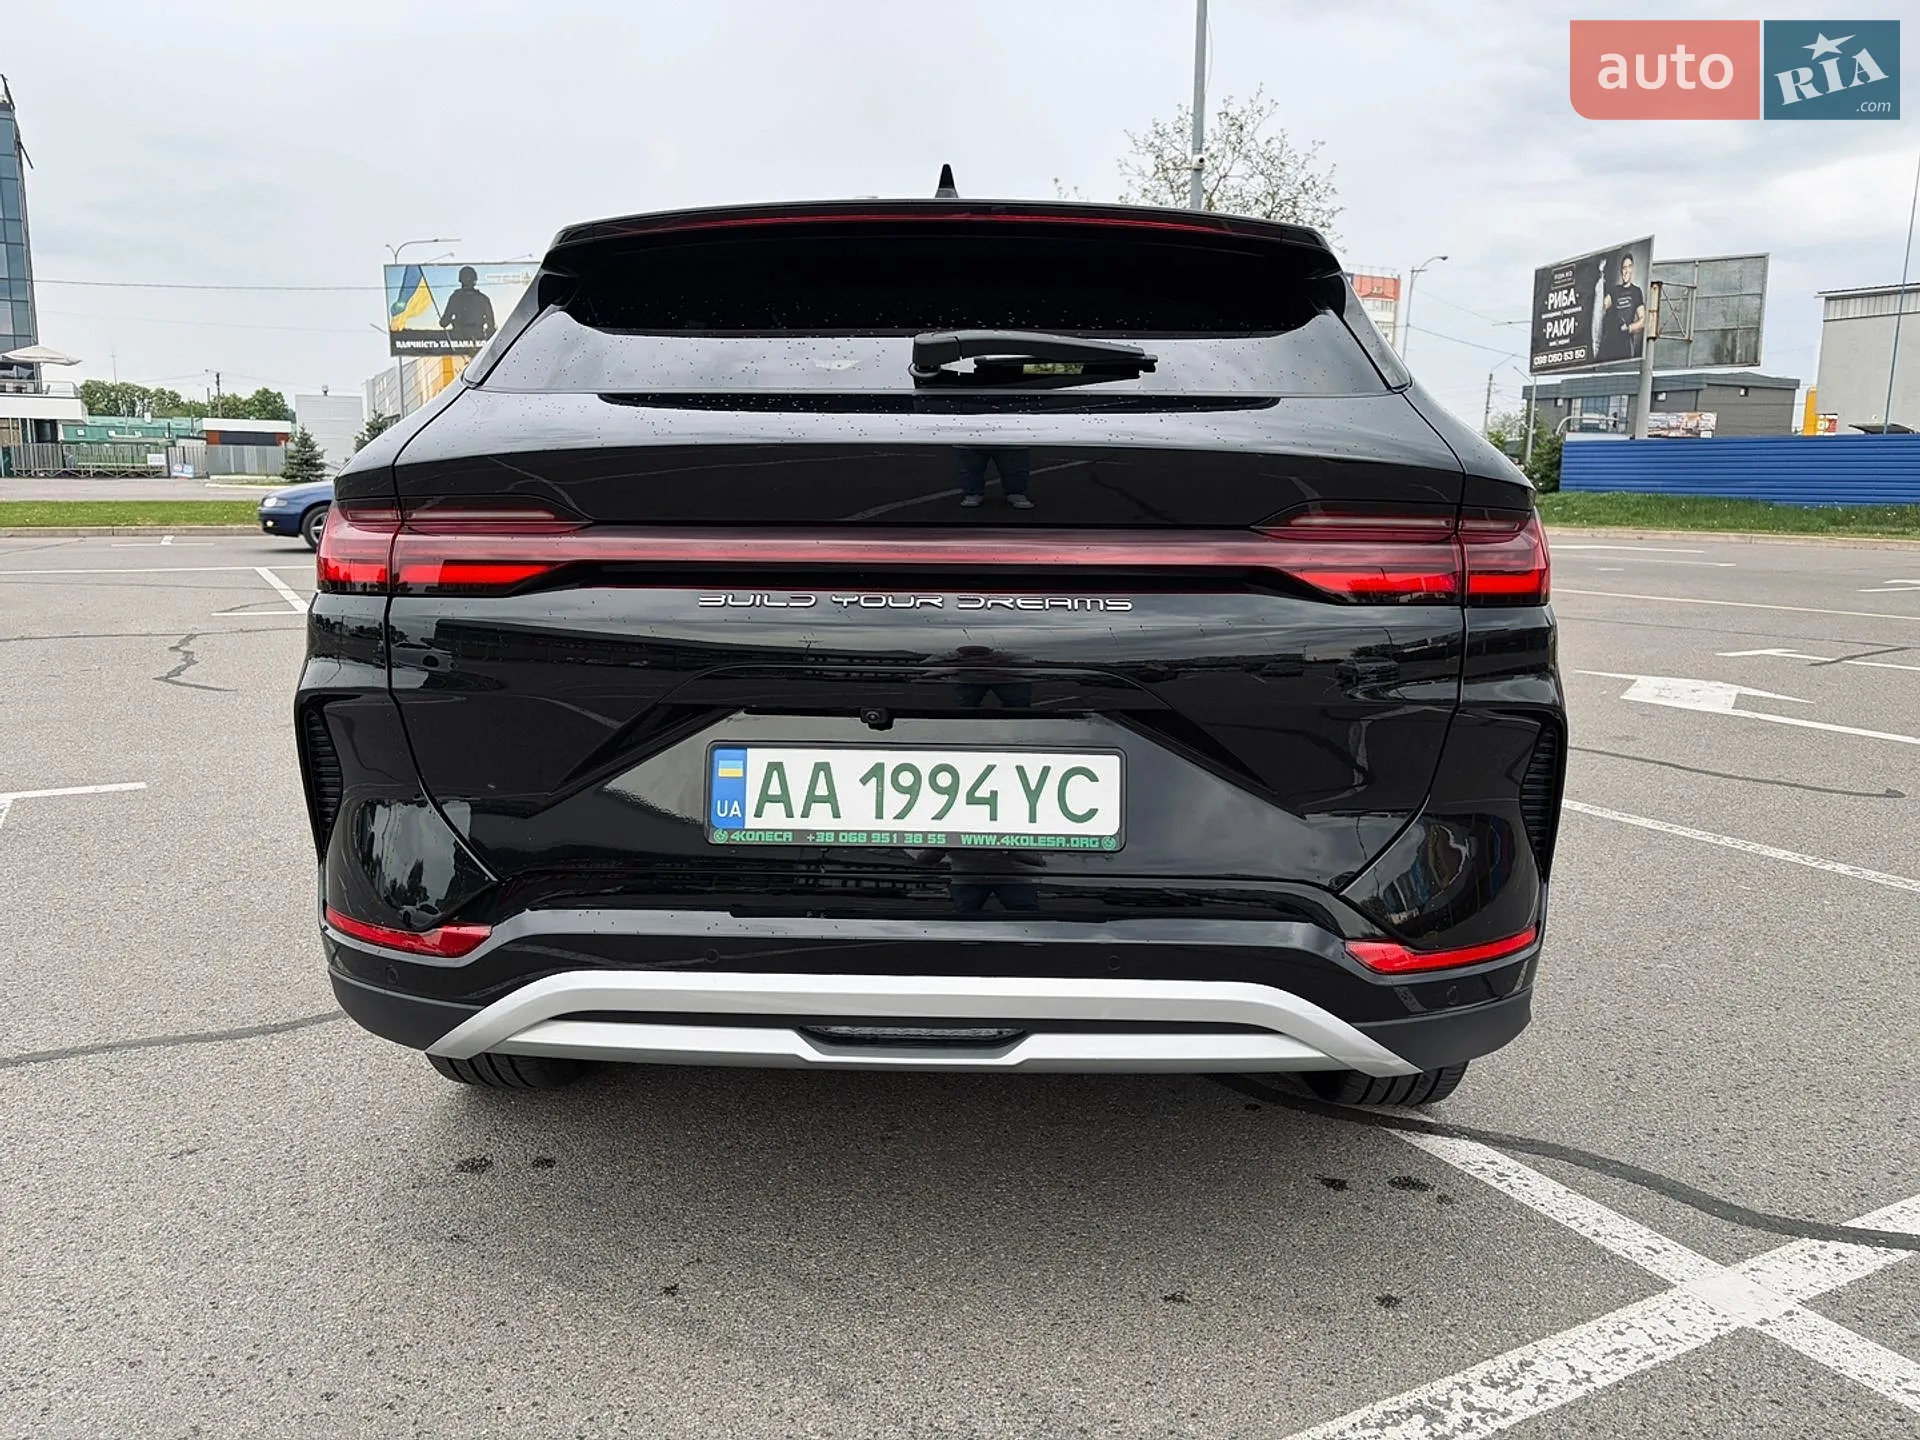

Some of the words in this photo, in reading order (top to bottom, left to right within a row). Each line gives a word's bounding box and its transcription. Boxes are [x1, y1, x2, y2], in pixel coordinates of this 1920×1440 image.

[1547, 288, 1577, 311] РИБА
[1545, 316, 1575, 339] РАКИ
[699, 594, 817, 607] BUILD
[831, 594, 943, 608] YOUR
[957, 595, 1134, 611] DREAMS
[753, 761, 842, 819] AA
[859, 762, 999, 821] 1994
[1014, 765, 1100, 824] YC
[716, 800, 743, 818] UA
[806, 831, 835, 843] +38
[839, 832, 867, 843] 068
[871, 832, 898, 844] 951
[903, 833, 923, 844] 38
[927, 833, 947, 845] 55
